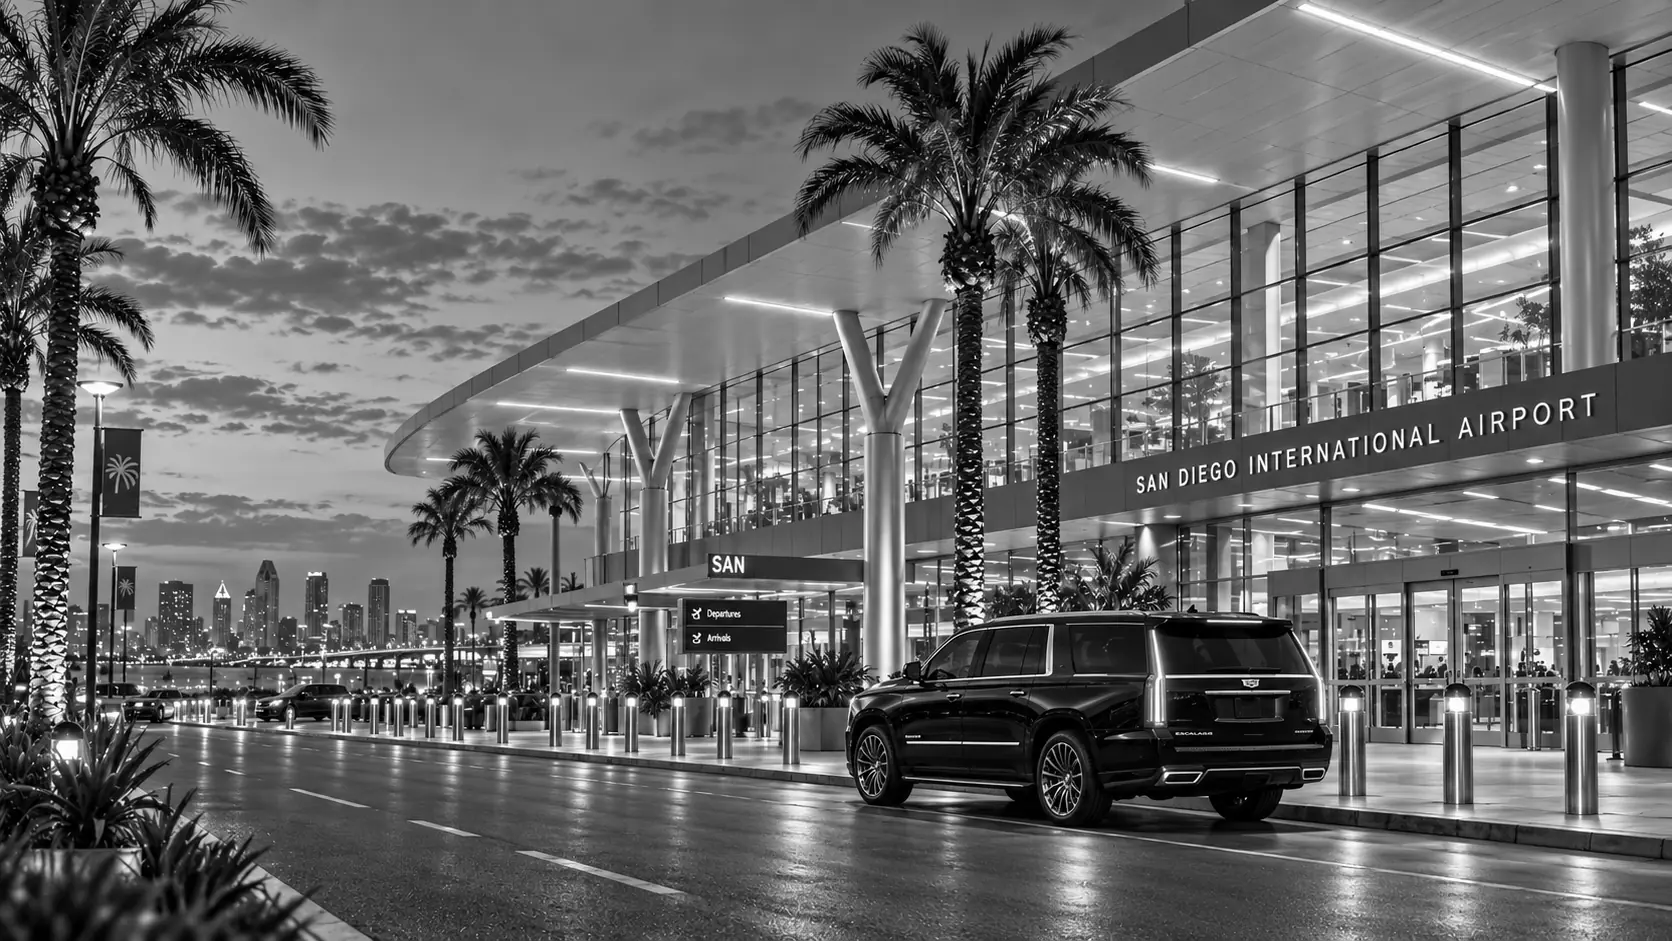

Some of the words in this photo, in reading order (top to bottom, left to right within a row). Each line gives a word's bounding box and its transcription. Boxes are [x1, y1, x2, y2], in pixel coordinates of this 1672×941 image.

[1136, 475, 1168, 494] SAN
[1178, 459, 1237, 487] DIEGO
[1249, 423, 1440, 475] INTERNATIONAL
[1458, 392, 1597, 440] AIRPORT
[712, 555, 745, 574] SAN
[707, 608, 741, 620] Departures
[707, 632, 731, 643] Arrivals
